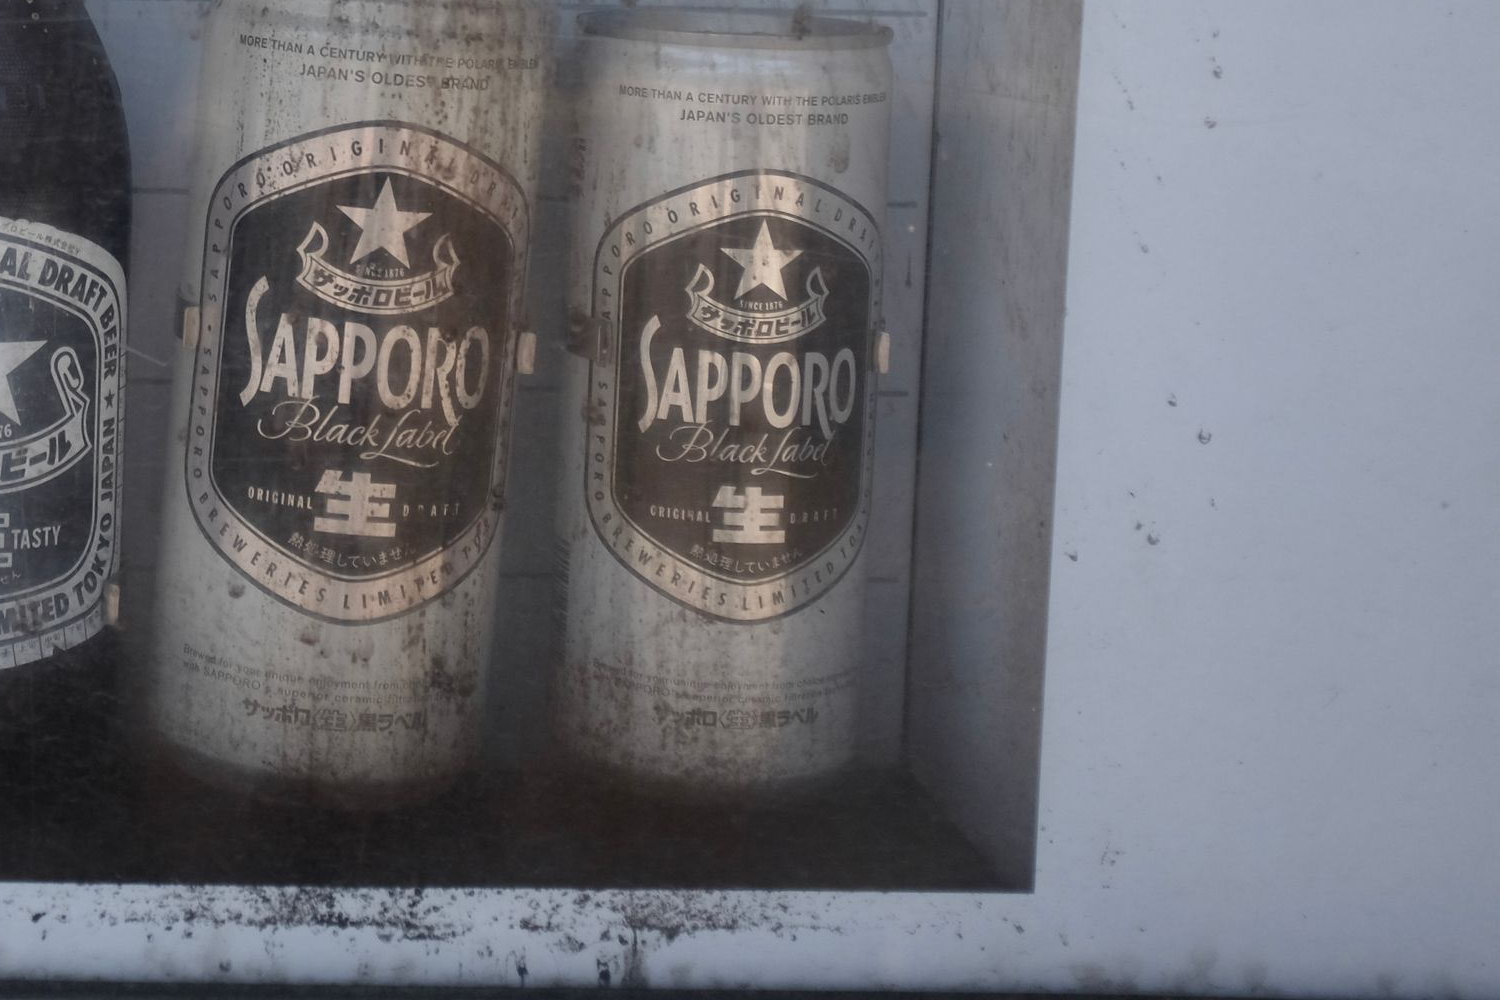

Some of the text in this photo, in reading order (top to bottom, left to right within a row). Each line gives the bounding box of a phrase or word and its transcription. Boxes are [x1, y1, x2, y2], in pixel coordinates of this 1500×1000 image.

[239, 33, 268, 50] MORE
[270, 39, 303, 55] THAN
[306, 44, 316, 56] A
[319, 46, 384, 64] CENTURY
[299, 63, 366, 84] JAPAN'S
[440, 77, 490, 91] BRAND
[619, 84, 649, 99] MORE
[650, 88, 682, 102] THAN
[685, 91, 695, 102] A
[697, 92, 759, 107] CENTURY
[760, 95, 793, 108] WITH
[795, 95, 818, 107] THE
[820, 94, 861, 106] POLARIS
[679, 108, 850, 126] JAPAN'S OLDEST BRAND
[207, 169, 267, 303] SAPPORO
[667, 185, 822, 225] ORIGINAL
[37, 257, 108, 314] DRAFT
[99, 303, 118, 381] BEER
[312, 269, 451, 307] サッポロビール
[240, 276, 490, 427] SAPPORO
[700, 305, 816, 337] サッポロビール
[637, 314, 857, 440] SAPPORO
[192, 348, 212, 479] SAPPORO
[257, 395, 380, 449] Black
[359, 408, 461, 468] Label
[655, 419, 770, 465] Black
[750, 426, 836, 480] Label
[72, 511, 113, 608] TOKYO
[100, 416, 117, 503] JAPAN
[247, 485, 313, 510] ORIGINAL
[313, 468, 397, 538] 生
[711, 485, 787, 544] 生
[11, 525, 62, 550] TASTY
[199, 492, 328, 602] BREWERIES
[601, 513, 727, 606] BREWERIES
[741, 561, 836, 611] LIMITED
